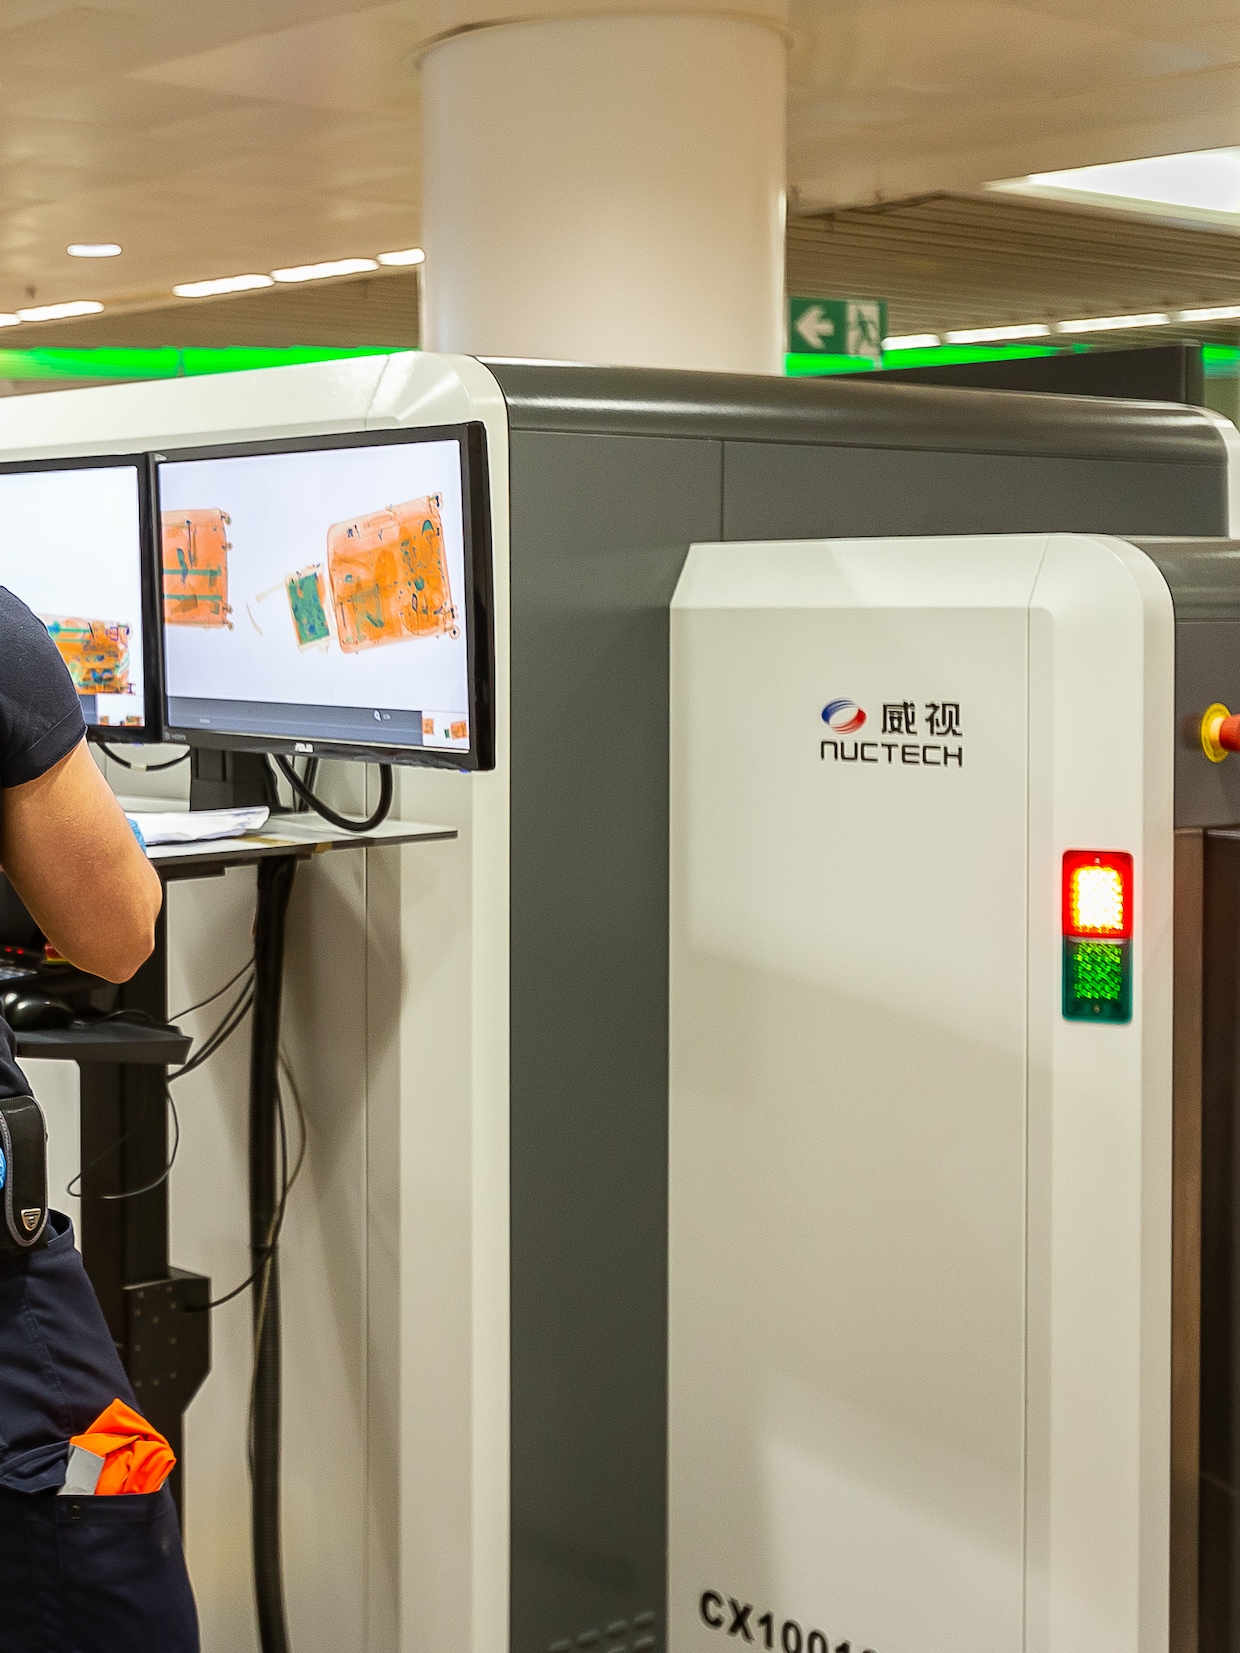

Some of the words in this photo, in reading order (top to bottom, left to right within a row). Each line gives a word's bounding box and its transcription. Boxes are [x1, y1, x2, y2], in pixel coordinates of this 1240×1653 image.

[881, 699, 963, 736] 威视
[820, 740, 963, 767] NUCTECH
[700, 1589, 879, 1653] CX100
